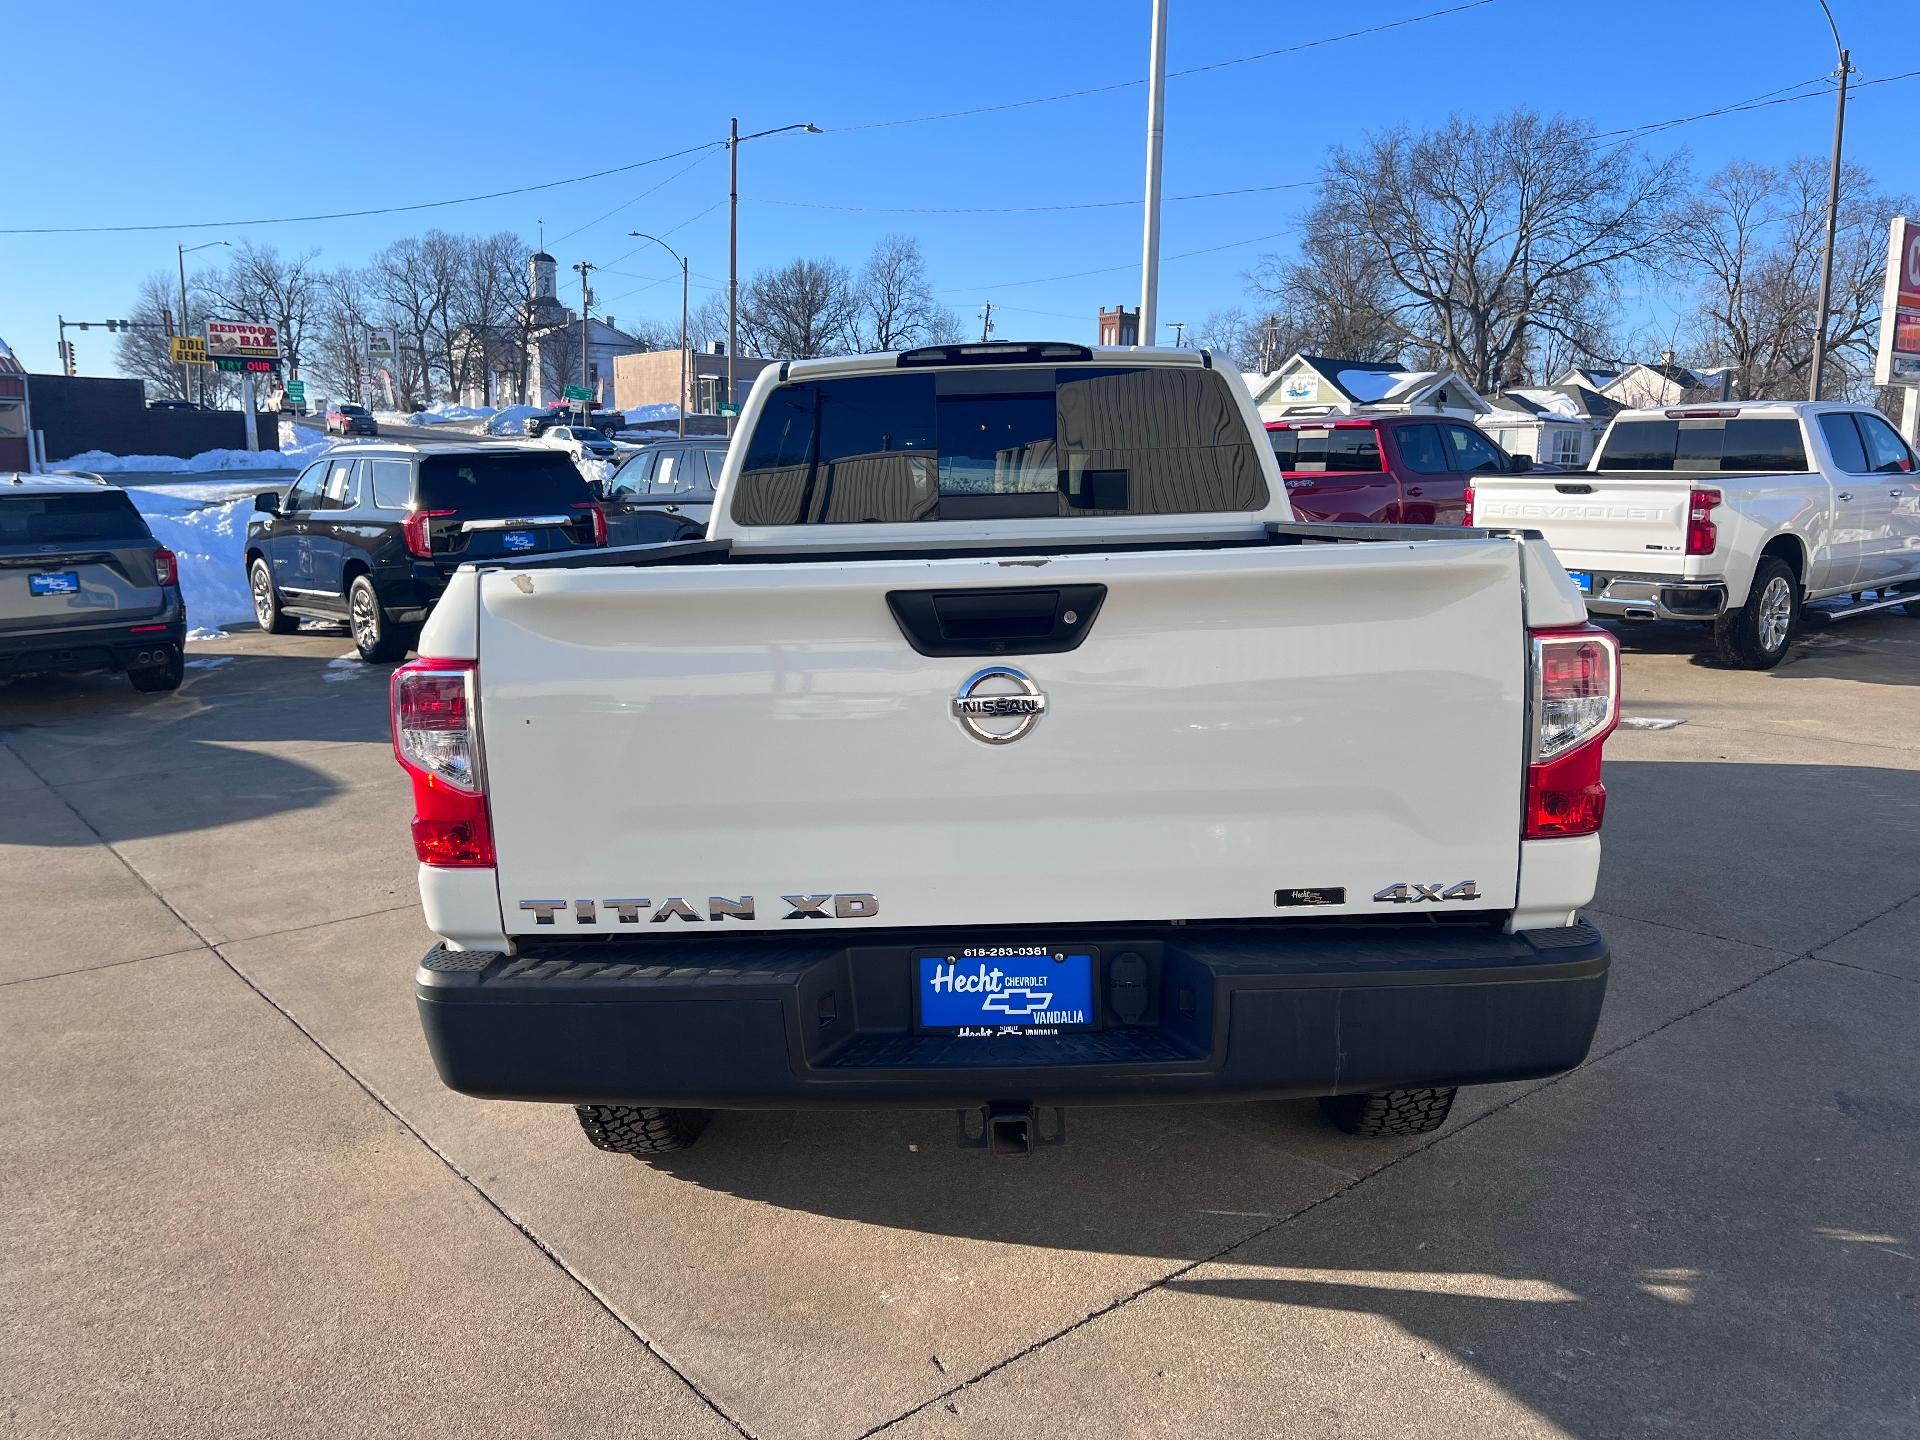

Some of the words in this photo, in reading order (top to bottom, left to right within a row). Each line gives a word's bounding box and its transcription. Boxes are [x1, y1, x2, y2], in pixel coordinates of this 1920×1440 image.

[221, 360, 243, 370] TRY
[247, 361, 271, 371] OUR
[1483, 503, 1671, 521] CHEVROLET
[962, 699, 1036, 713] NISSAN
[519, 895, 755, 924] TITAN
[782, 894, 880, 920] XD
[963, 947, 1048, 957] 618-283-0381
[930, 963, 1004, 994] Hecht
[1004, 976, 1048, 987] CHEVROLET
[1033, 1010, 1084, 1024] VANDALIA
